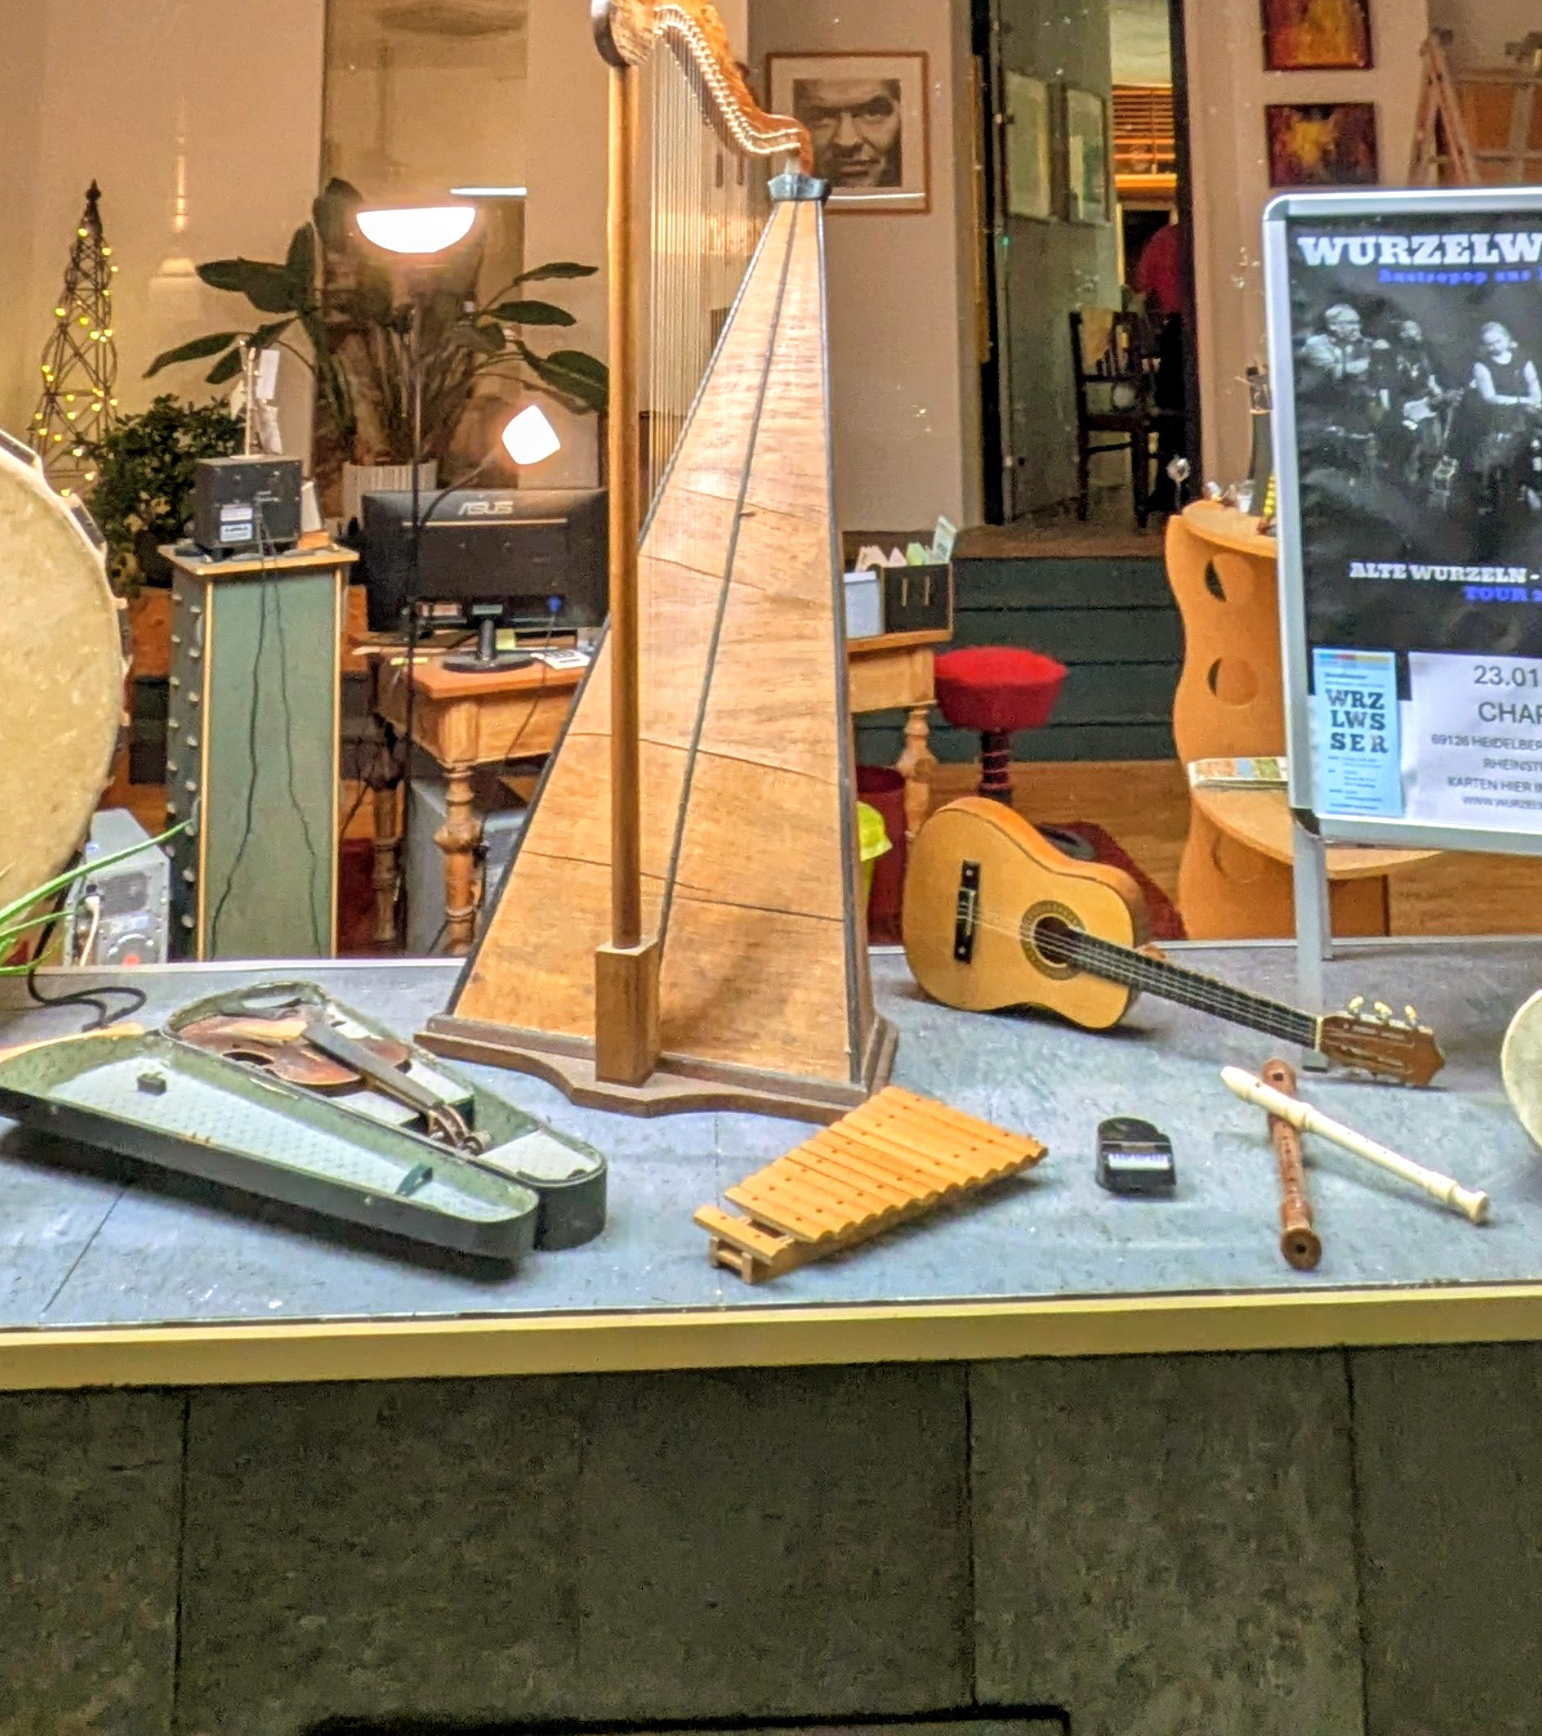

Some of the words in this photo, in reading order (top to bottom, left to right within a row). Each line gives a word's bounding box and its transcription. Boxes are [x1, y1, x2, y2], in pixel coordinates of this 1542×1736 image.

[458, 500, 514, 516] ASUS
[1349, 562, 1407, 579] ALTE
[1408, 565, 1527, 584] WURZELN
[1464, 586, 1528, 603] TOUR
[1325, 688, 1385, 710] WRZ
[1331, 710, 1386, 731] LWS
[1330, 732, 1389, 754] SER
[1431, 734, 1469, 746] 69126
[1447, 777, 1498, 791] KARTEN
[1500, 781, 1531, 792] HIER
